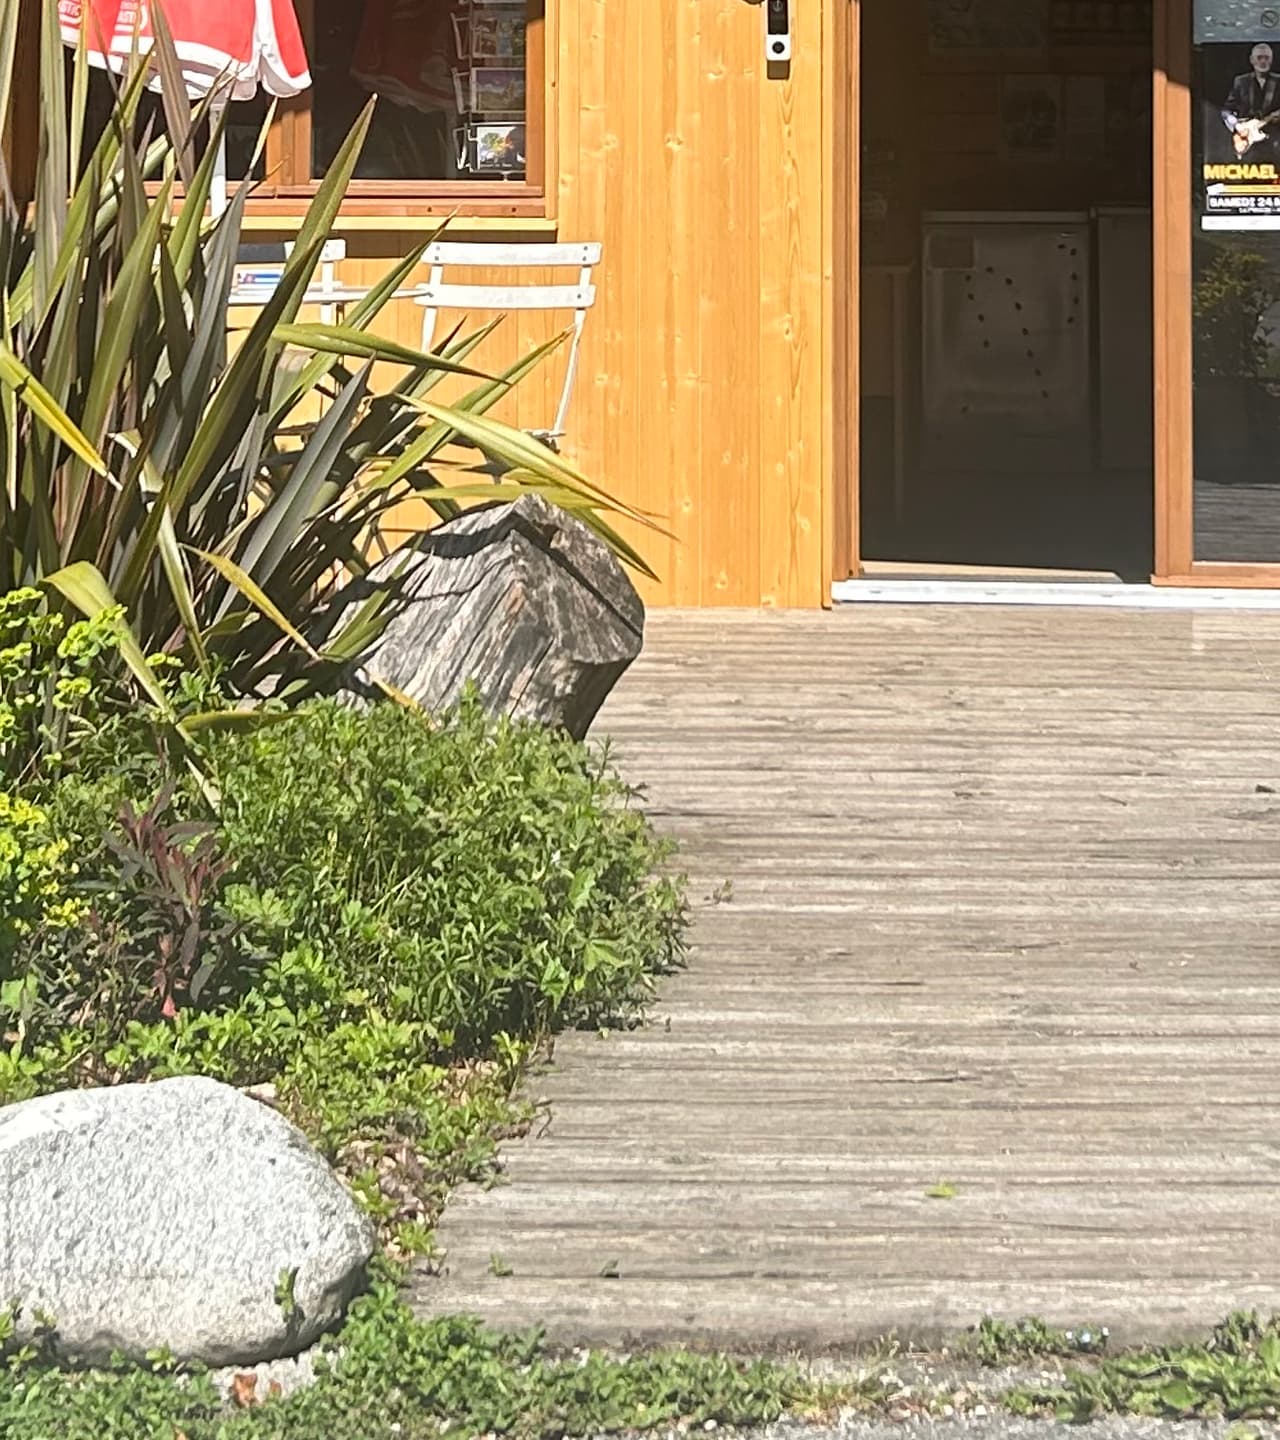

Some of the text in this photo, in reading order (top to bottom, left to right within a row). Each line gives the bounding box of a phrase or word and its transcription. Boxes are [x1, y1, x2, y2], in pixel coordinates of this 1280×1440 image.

[1203, 164, 1278, 180] MICHAEL
[1209, 196, 1256, 208] SAMEDI
[1257, 196, 1273, 208] 24
